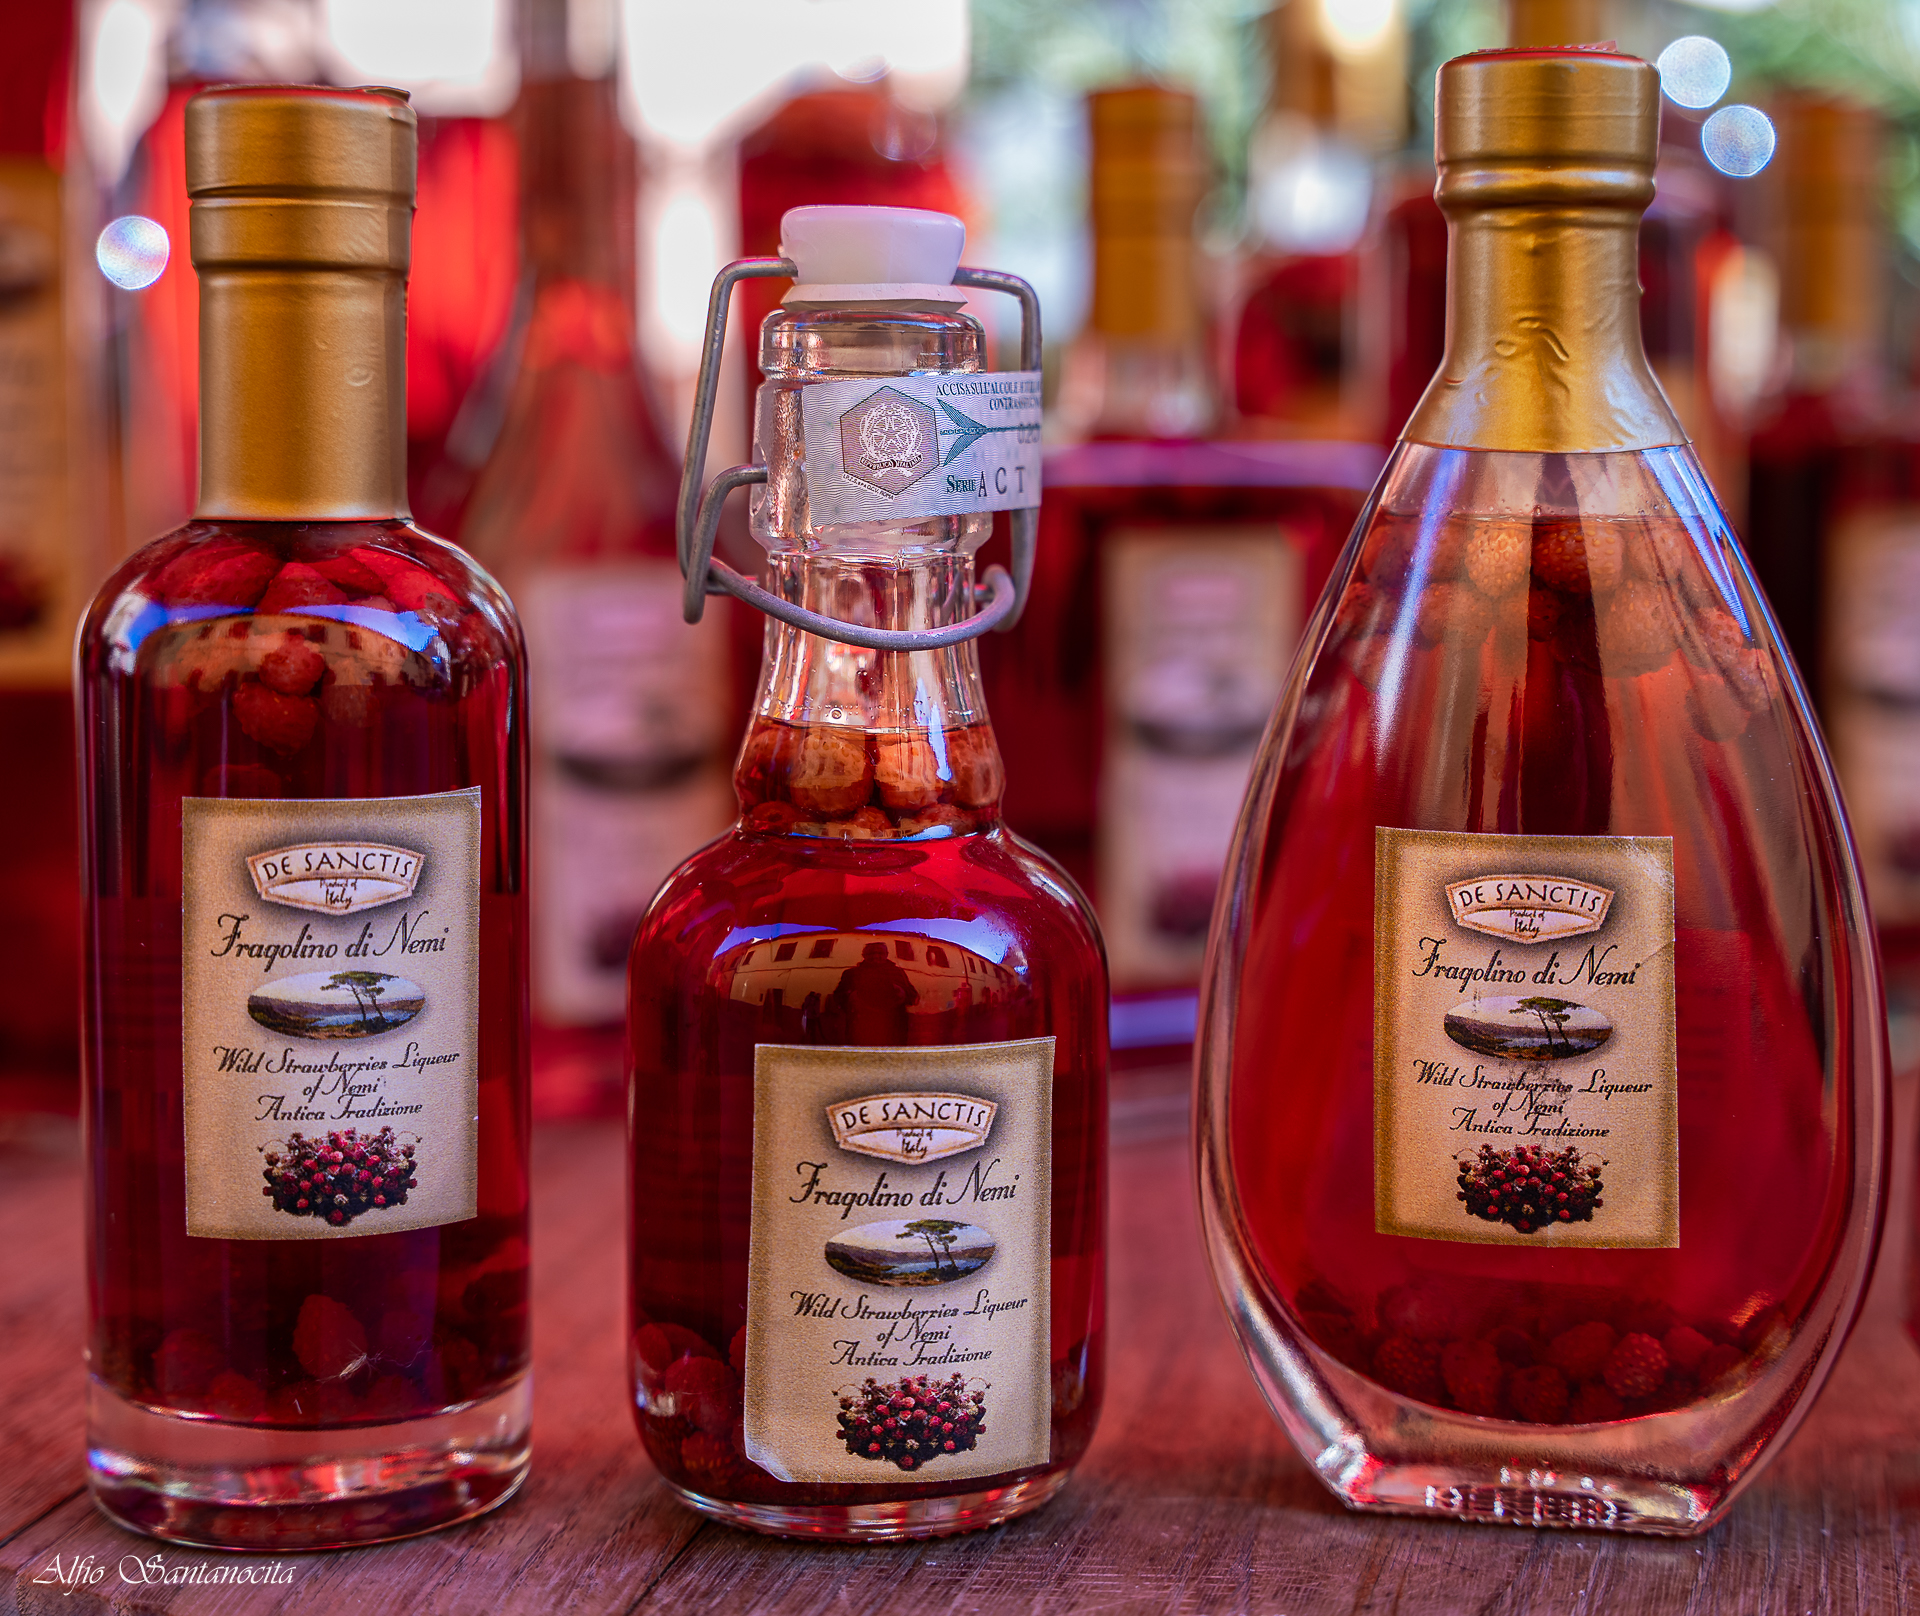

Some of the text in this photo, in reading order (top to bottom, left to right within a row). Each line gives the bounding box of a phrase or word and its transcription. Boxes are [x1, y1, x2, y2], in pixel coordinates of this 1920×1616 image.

[936, 383, 969, 396] ACCISA
[262, 852, 412, 880] DE SANCTIS
[320, 878, 358, 890] Product of
[1458, 883, 1601, 912] DE SANCTIS
[325, 888, 352, 909] Italy
[1509, 909, 1545, 921] Product of
[1514, 918, 1540, 939] Italy
[210, 911, 449, 972] Fragolino di Nemi
[1412, 937, 1640, 993] Fragolino di Nemi
[213, 1042, 460, 1074] Wild Strawberries Liqueur
[303, 1068, 381, 1103] of Nemi
[1413, 1059, 1653, 1100] Wild Strawberries Liqueur
[255, 1093, 423, 1121] Antica Tradizione
[841, 1102, 985, 1129] DE SANCTIS
[1492, 1089, 1566, 1117] of Nemi
[896, 1128, 933, 1141] Product of
[1450, 1107, 1610, 1138] Antica Tradizione
[902, 1137, 928, 1159] Italy
[789, 1158, 1019, 1219] Fragolino di Nemi
[790, 1288, 1028, 1321] Wild Strawberries Liqueur
[877, 1315, 952, 1349] of Nemi
[830, 1340, 992, 1366] Antica Tradizione
